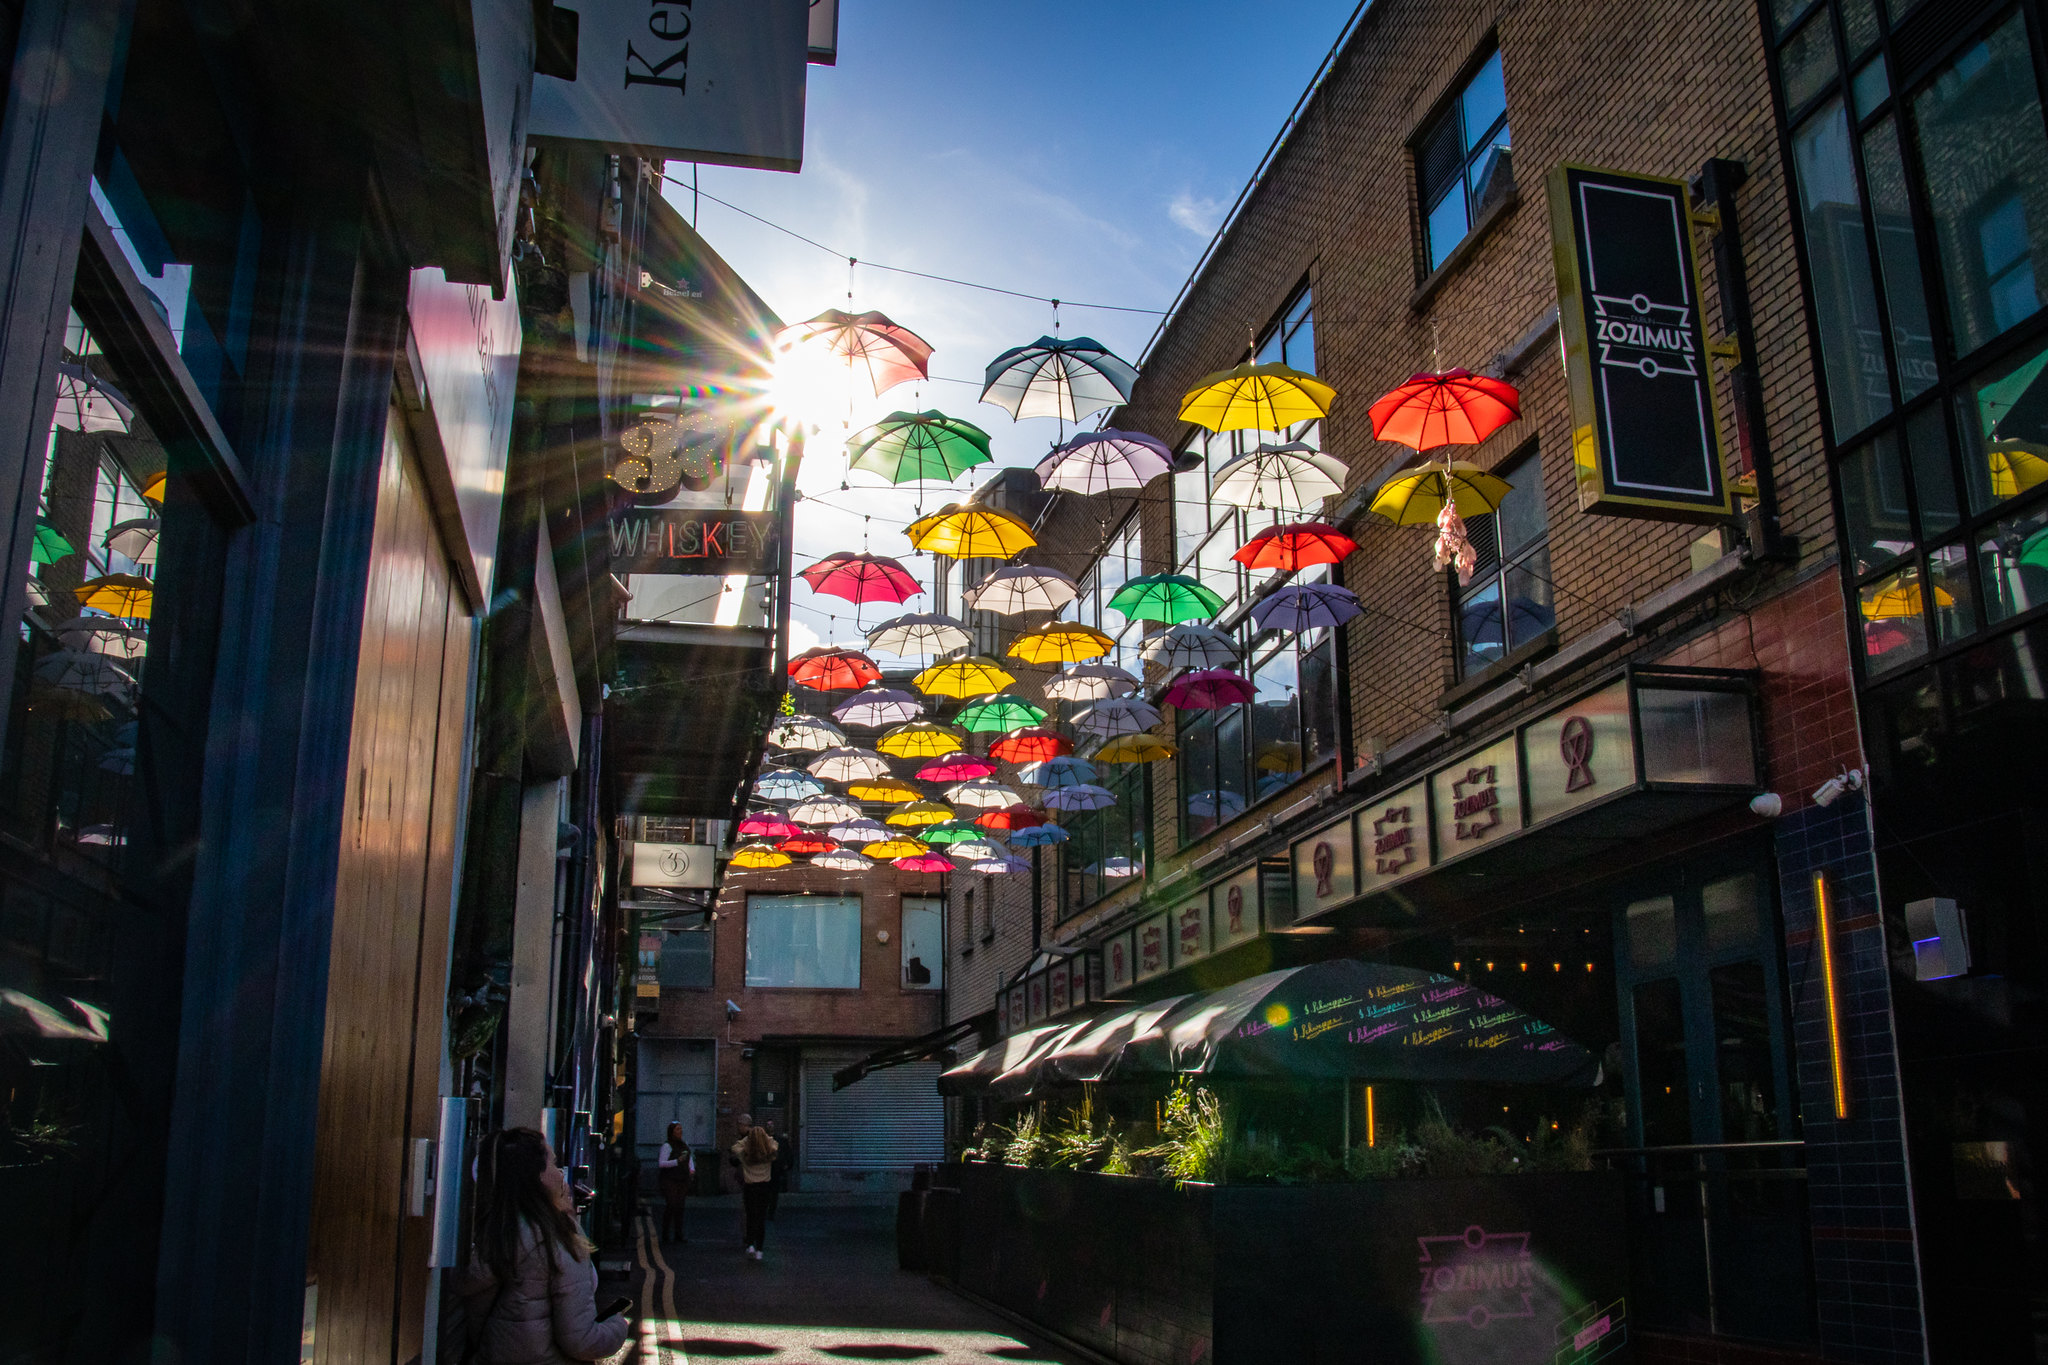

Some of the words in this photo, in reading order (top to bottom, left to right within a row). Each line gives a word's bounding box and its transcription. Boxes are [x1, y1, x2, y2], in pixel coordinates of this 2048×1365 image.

[1595, 319, 1695, 353] ZOZIMUS
[610, 517, 772, 560] WHISKEY
[1419, 1261, 1534, 1293] ZOZIMUS
